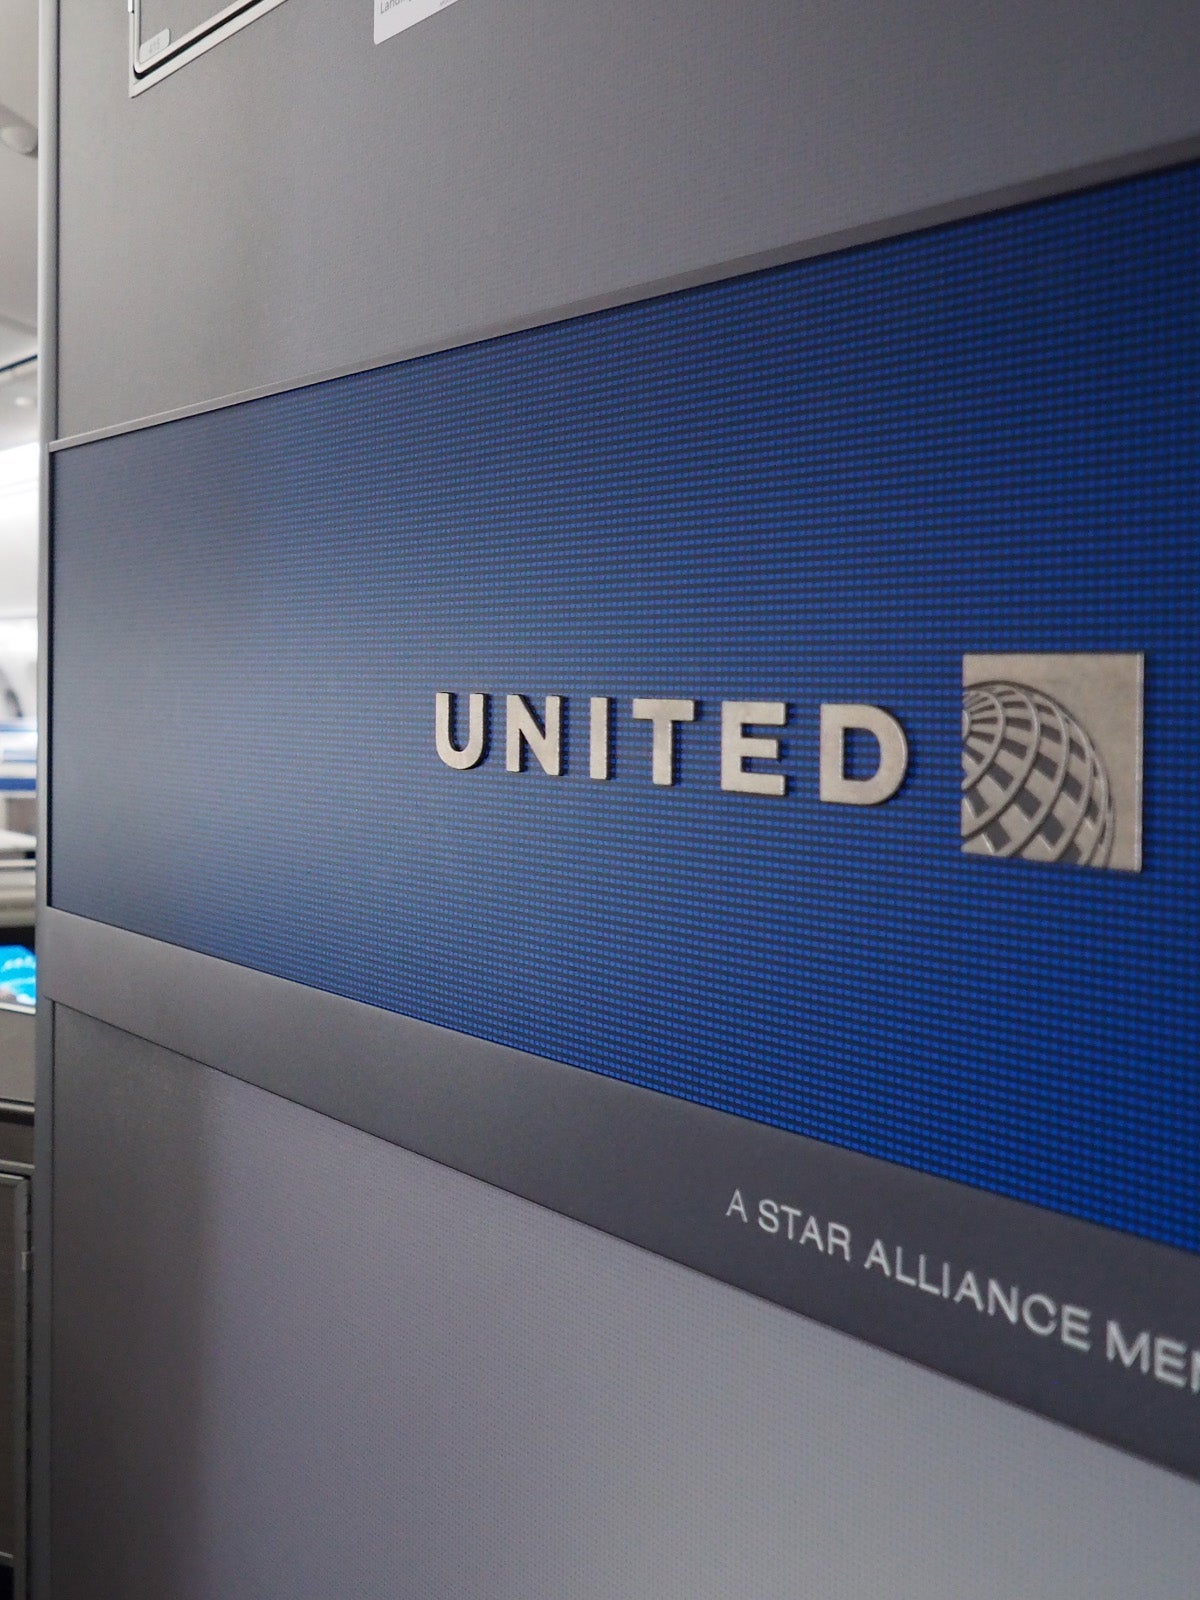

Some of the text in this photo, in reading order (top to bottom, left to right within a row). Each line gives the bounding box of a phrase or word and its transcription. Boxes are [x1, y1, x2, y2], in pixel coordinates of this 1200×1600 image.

[435, 692, 908, 805] UNITED
[726, 1188, 1200, 1394] A STAR ALLIANCE ME
